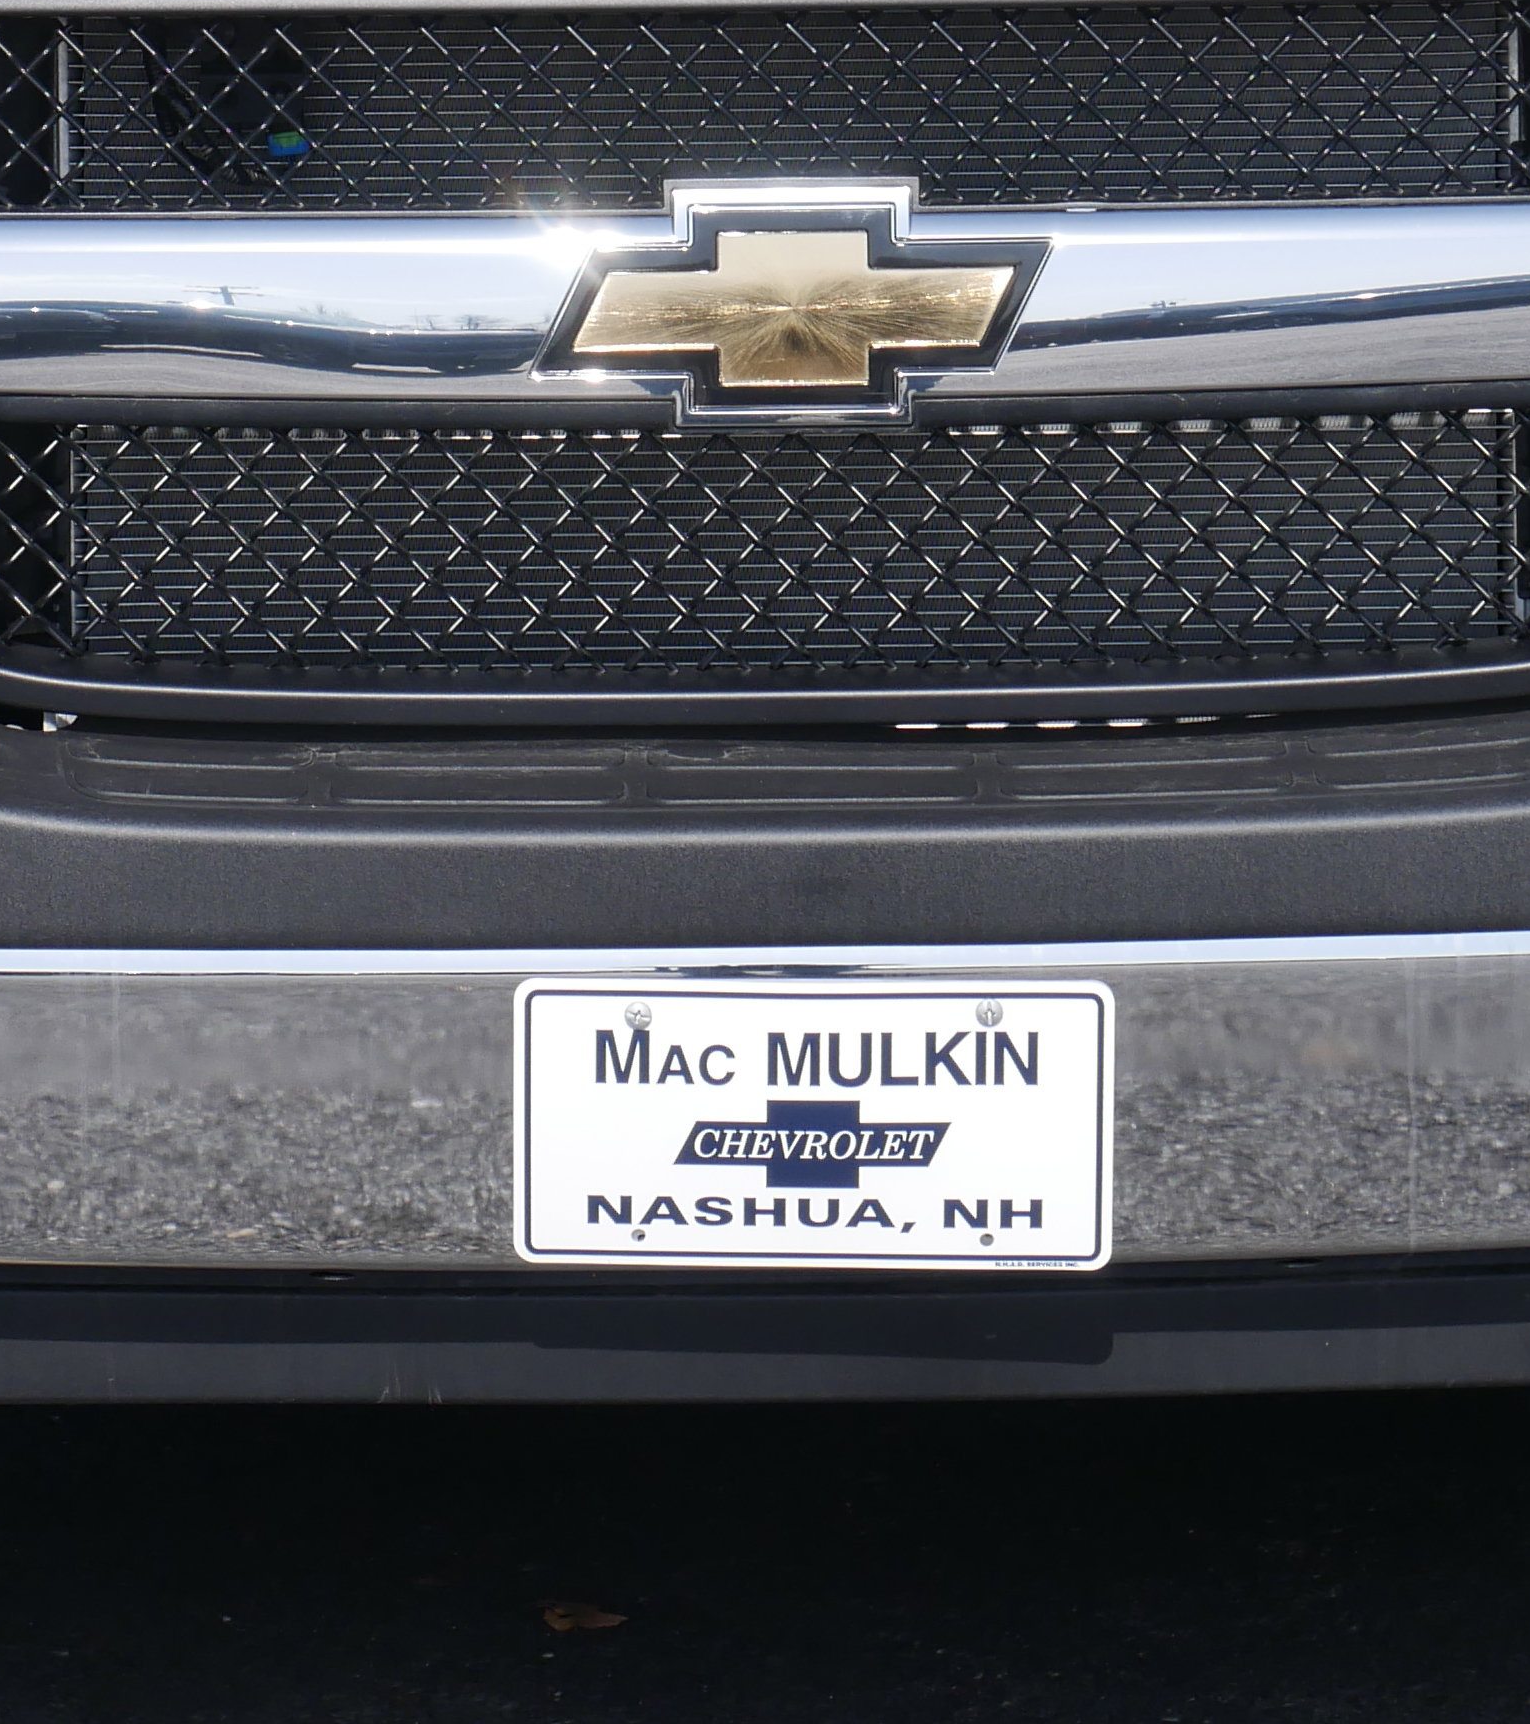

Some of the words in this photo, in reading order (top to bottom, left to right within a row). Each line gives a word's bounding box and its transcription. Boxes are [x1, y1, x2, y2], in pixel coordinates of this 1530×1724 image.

[768, 1031, 1040, 1088] MULKIN
[693, 1128, 936, 1161] CHEVROLET
[587, 1194, 916, 1233] NASHUA,
[943, 1198, 1044, 1229] NH
